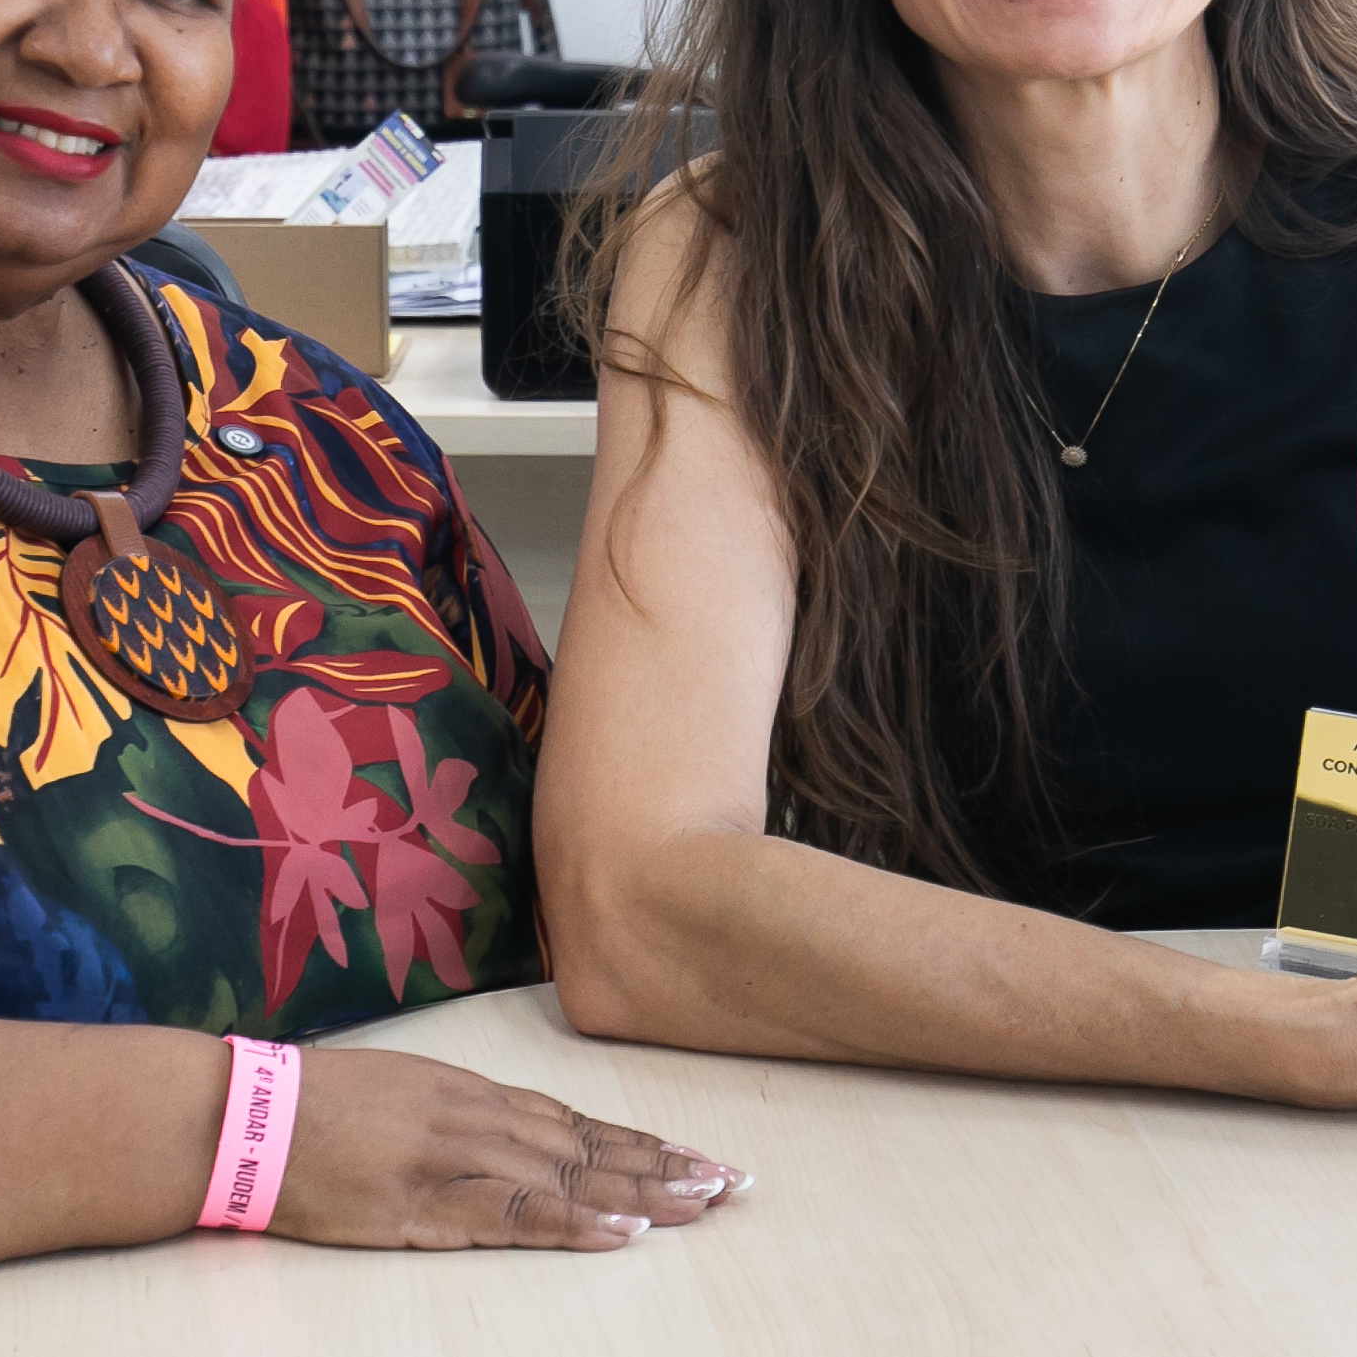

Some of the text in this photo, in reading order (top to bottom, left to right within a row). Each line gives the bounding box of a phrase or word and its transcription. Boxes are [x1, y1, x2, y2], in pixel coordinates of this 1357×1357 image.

[1305, 811, 1339, 832] SUA
[243, 1085, 272, 1143] ANDAR
[226, 1158, 260, 1215] NUDEM
